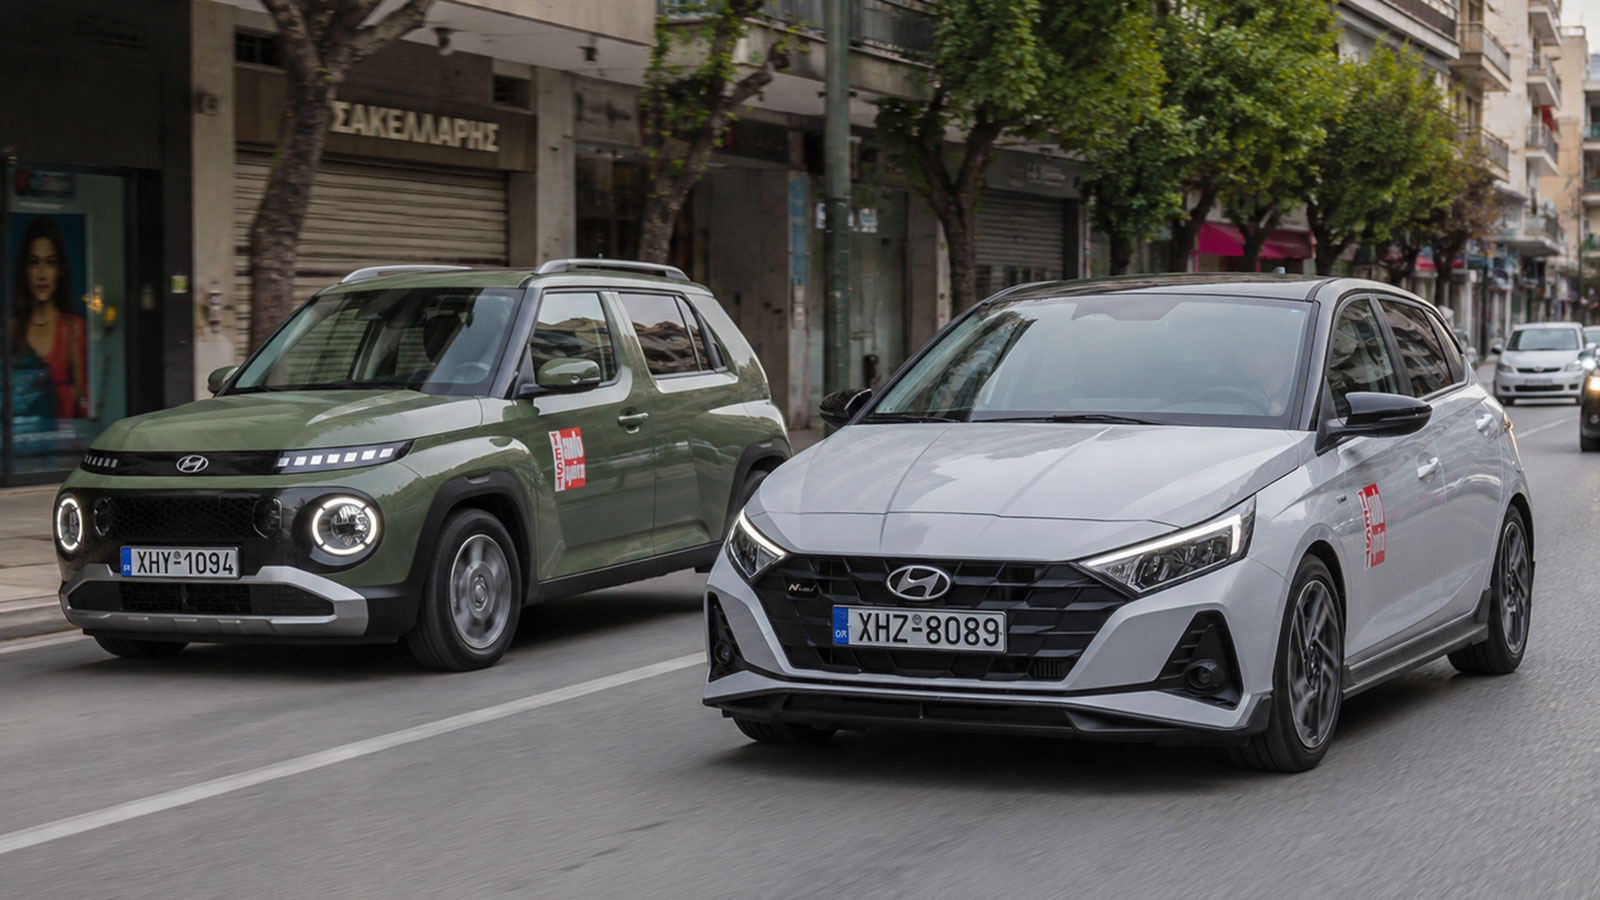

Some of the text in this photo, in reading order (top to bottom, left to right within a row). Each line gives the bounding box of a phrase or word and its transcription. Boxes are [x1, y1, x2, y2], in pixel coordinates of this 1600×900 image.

[329, 100, 500, 152] ΣΑΚΕΛΛΑΡΗΣ
[551, 432, 564, 489] TEST
[137, 551, 234, 575] XHY-1094
[858, 612, 1000, 647] XHZ-8089
